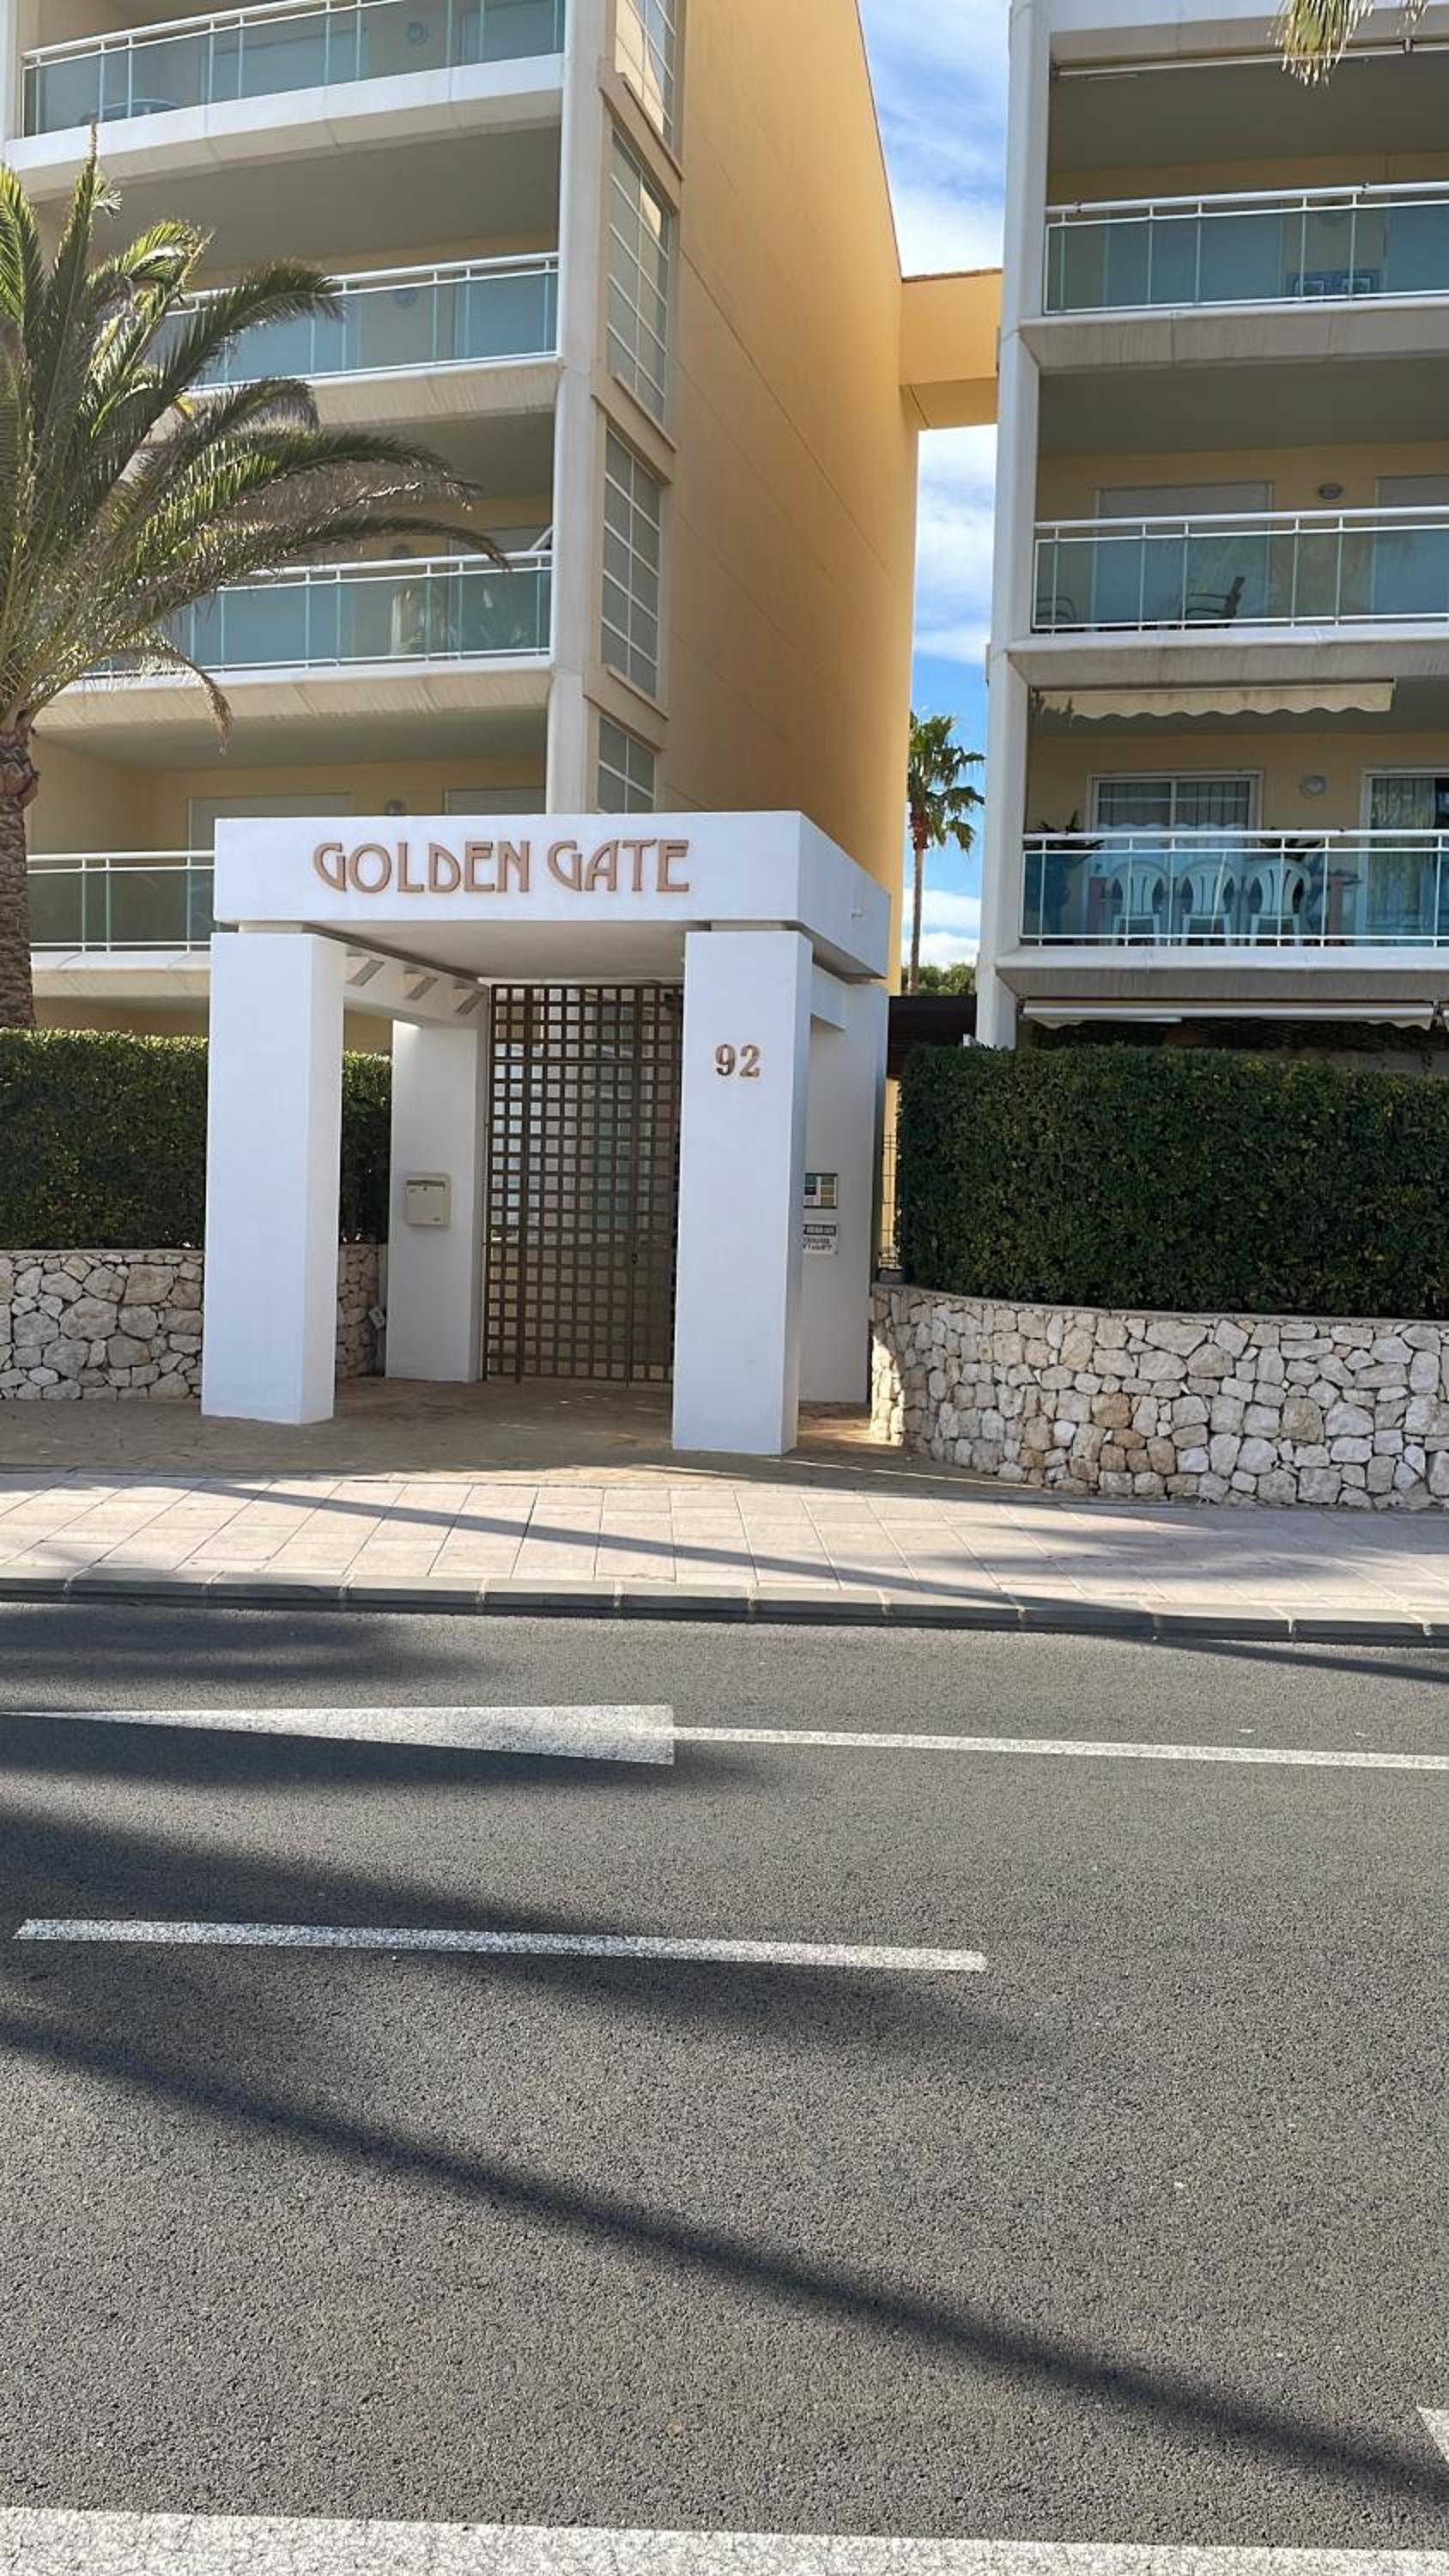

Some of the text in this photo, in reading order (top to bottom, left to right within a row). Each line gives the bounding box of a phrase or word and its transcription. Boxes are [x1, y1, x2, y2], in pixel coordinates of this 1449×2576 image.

[313, 839, 690, 893] GOLDEN GATE
[715, 1043, 761, 1078] 92
